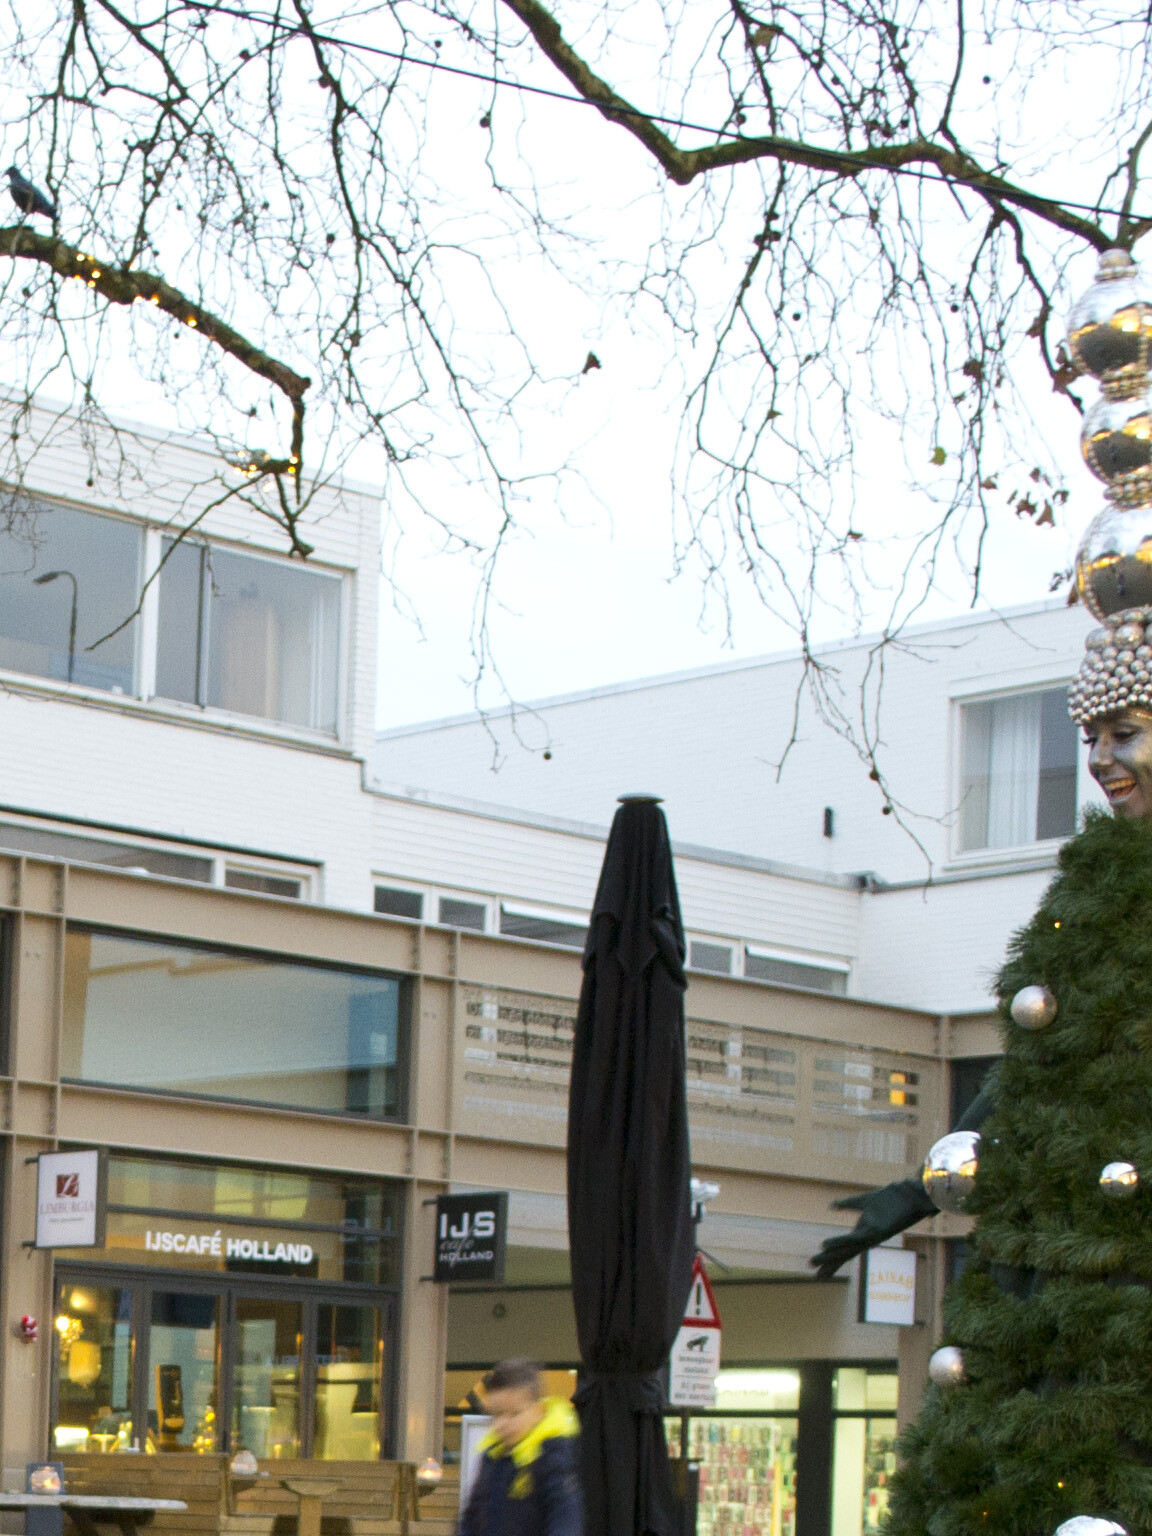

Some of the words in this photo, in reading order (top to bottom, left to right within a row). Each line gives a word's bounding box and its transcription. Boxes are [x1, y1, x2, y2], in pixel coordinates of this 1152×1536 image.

[440, 1211, 495, 1238] IJS
[145, 1230, 222, 1255] IJSCAFÉ
[226, 1238, 313, 1264] HOLLAND
[439, 1251, 493, 1261] HOLLAND
